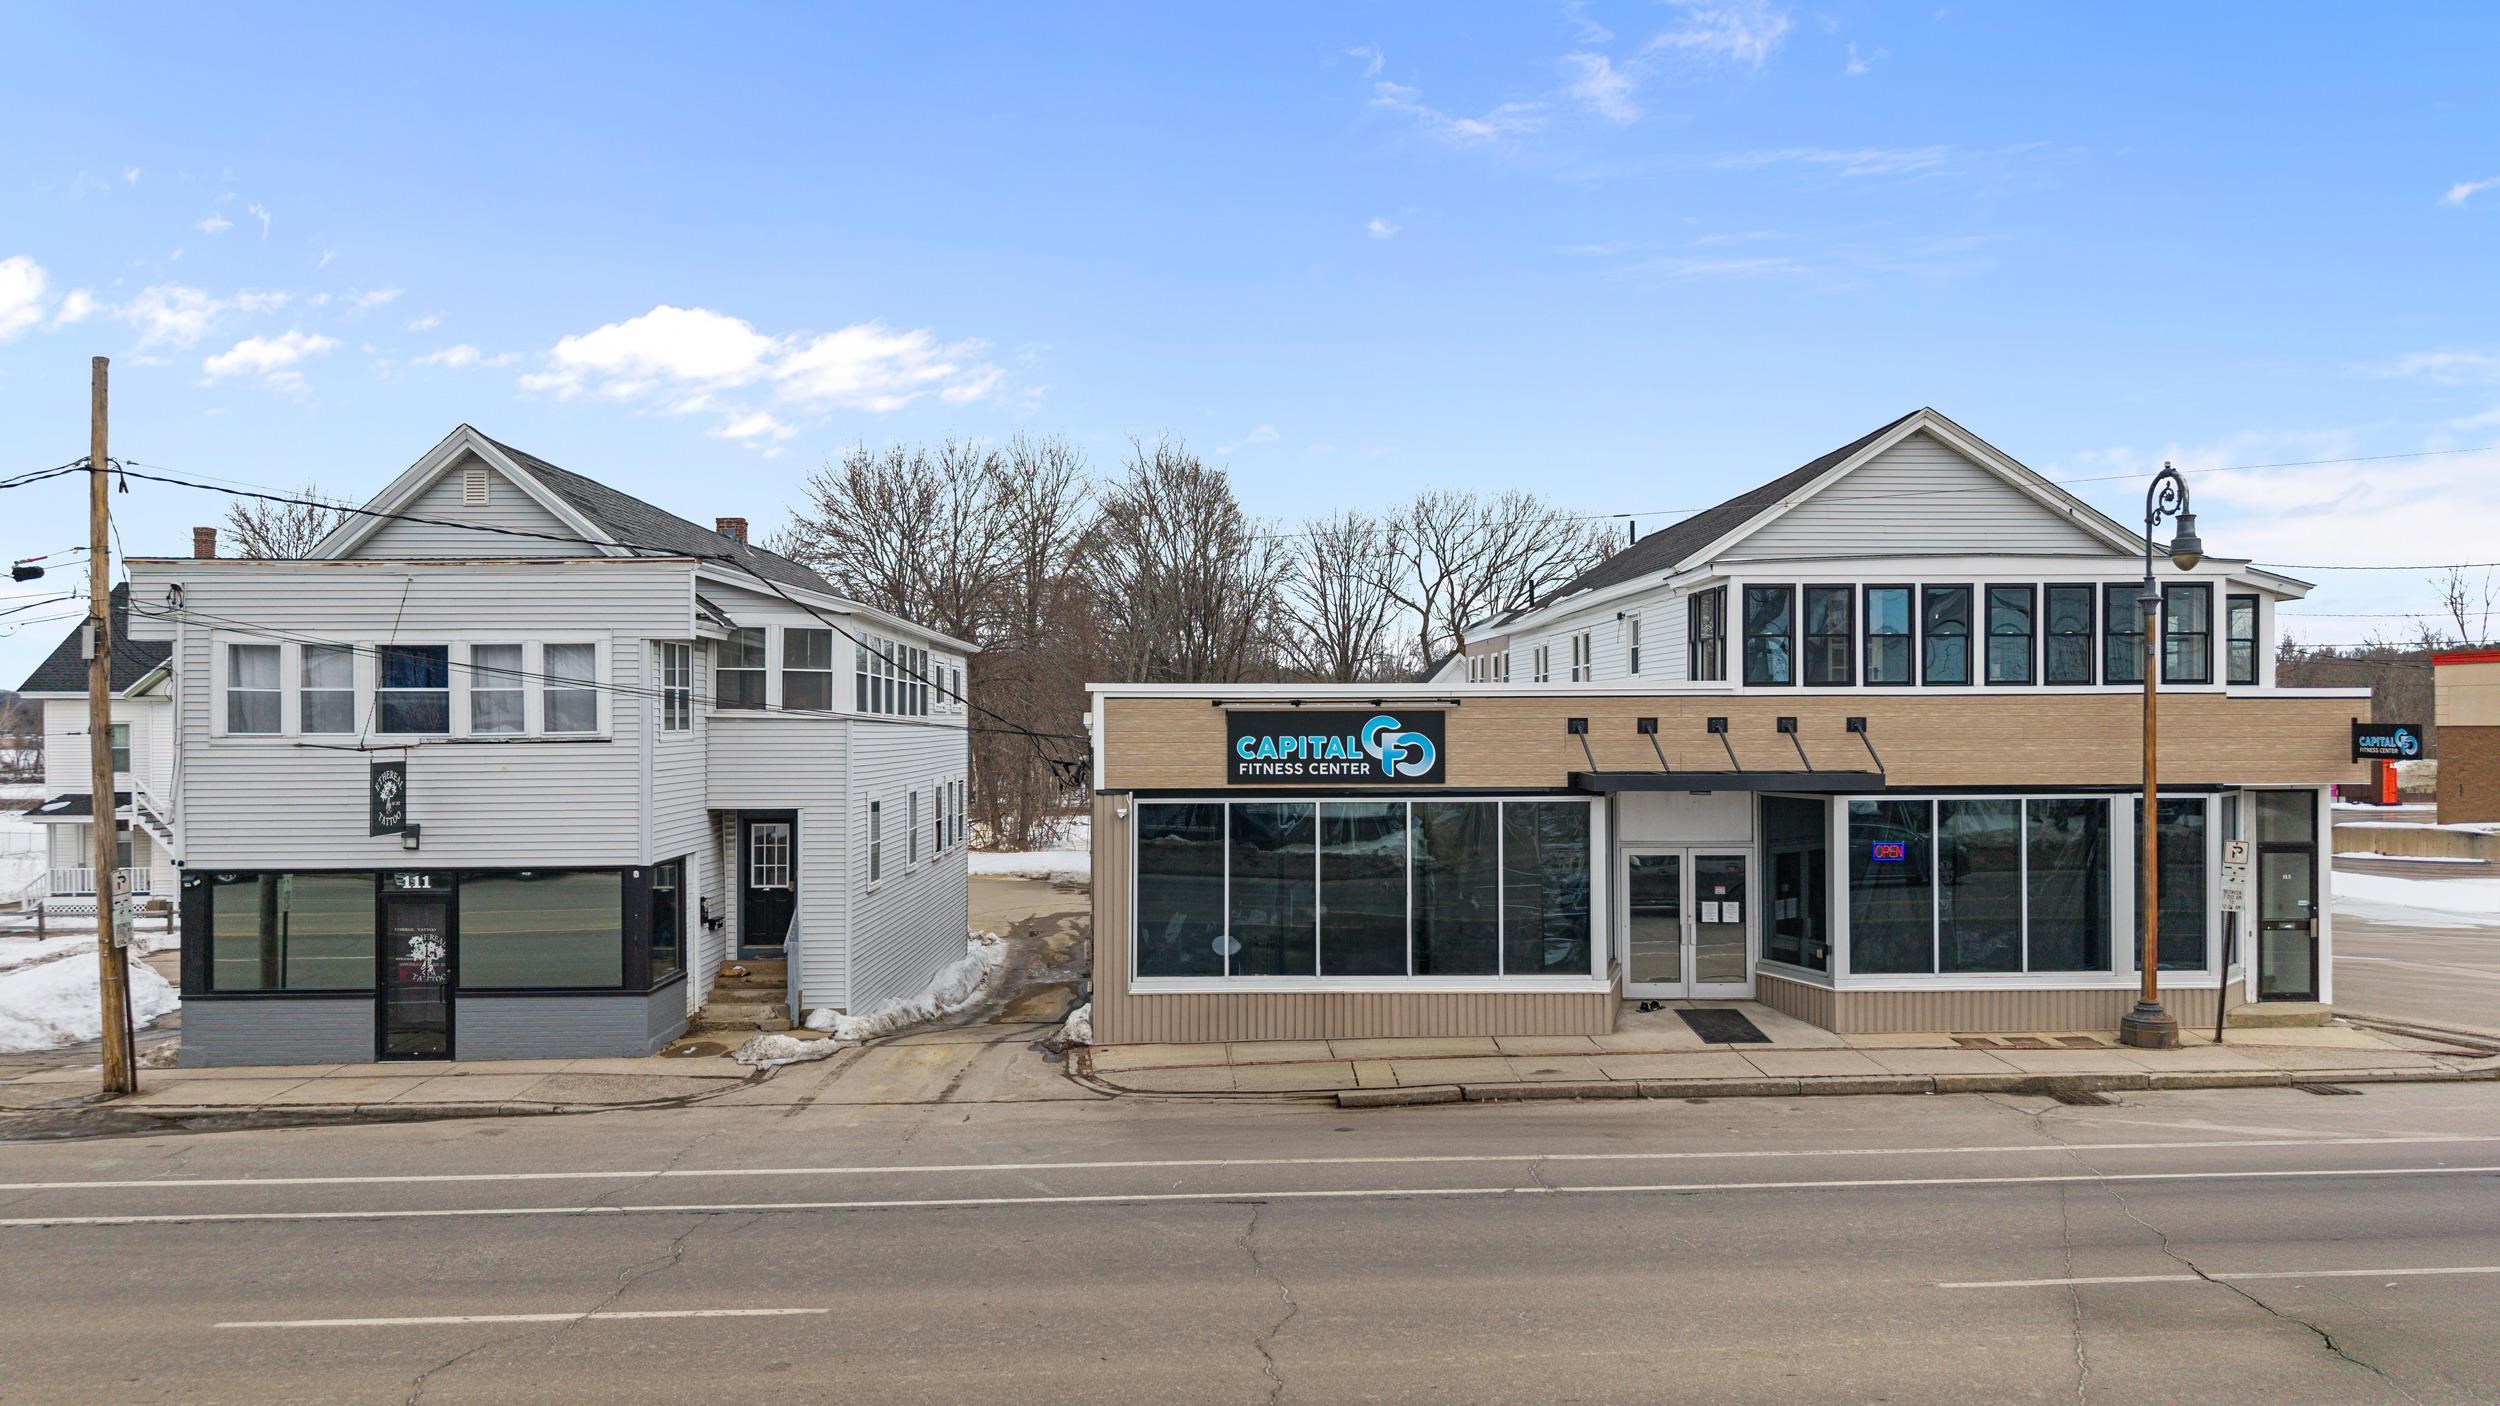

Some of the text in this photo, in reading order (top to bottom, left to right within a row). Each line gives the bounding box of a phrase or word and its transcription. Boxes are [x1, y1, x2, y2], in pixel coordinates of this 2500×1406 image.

[1236, 735, 1363, 760] CAPITAL
[2359, 736, 2396, 747] CAPITAL
[1239, 763, 1370, 775] FITNESS CENTER
[374, 770, 403, 791] ETHEREAL
[379, 811, 401, 826] TATTOO
[1875, 845, 1904, 858] OPEN
[403, 875, 431, 889] 111
